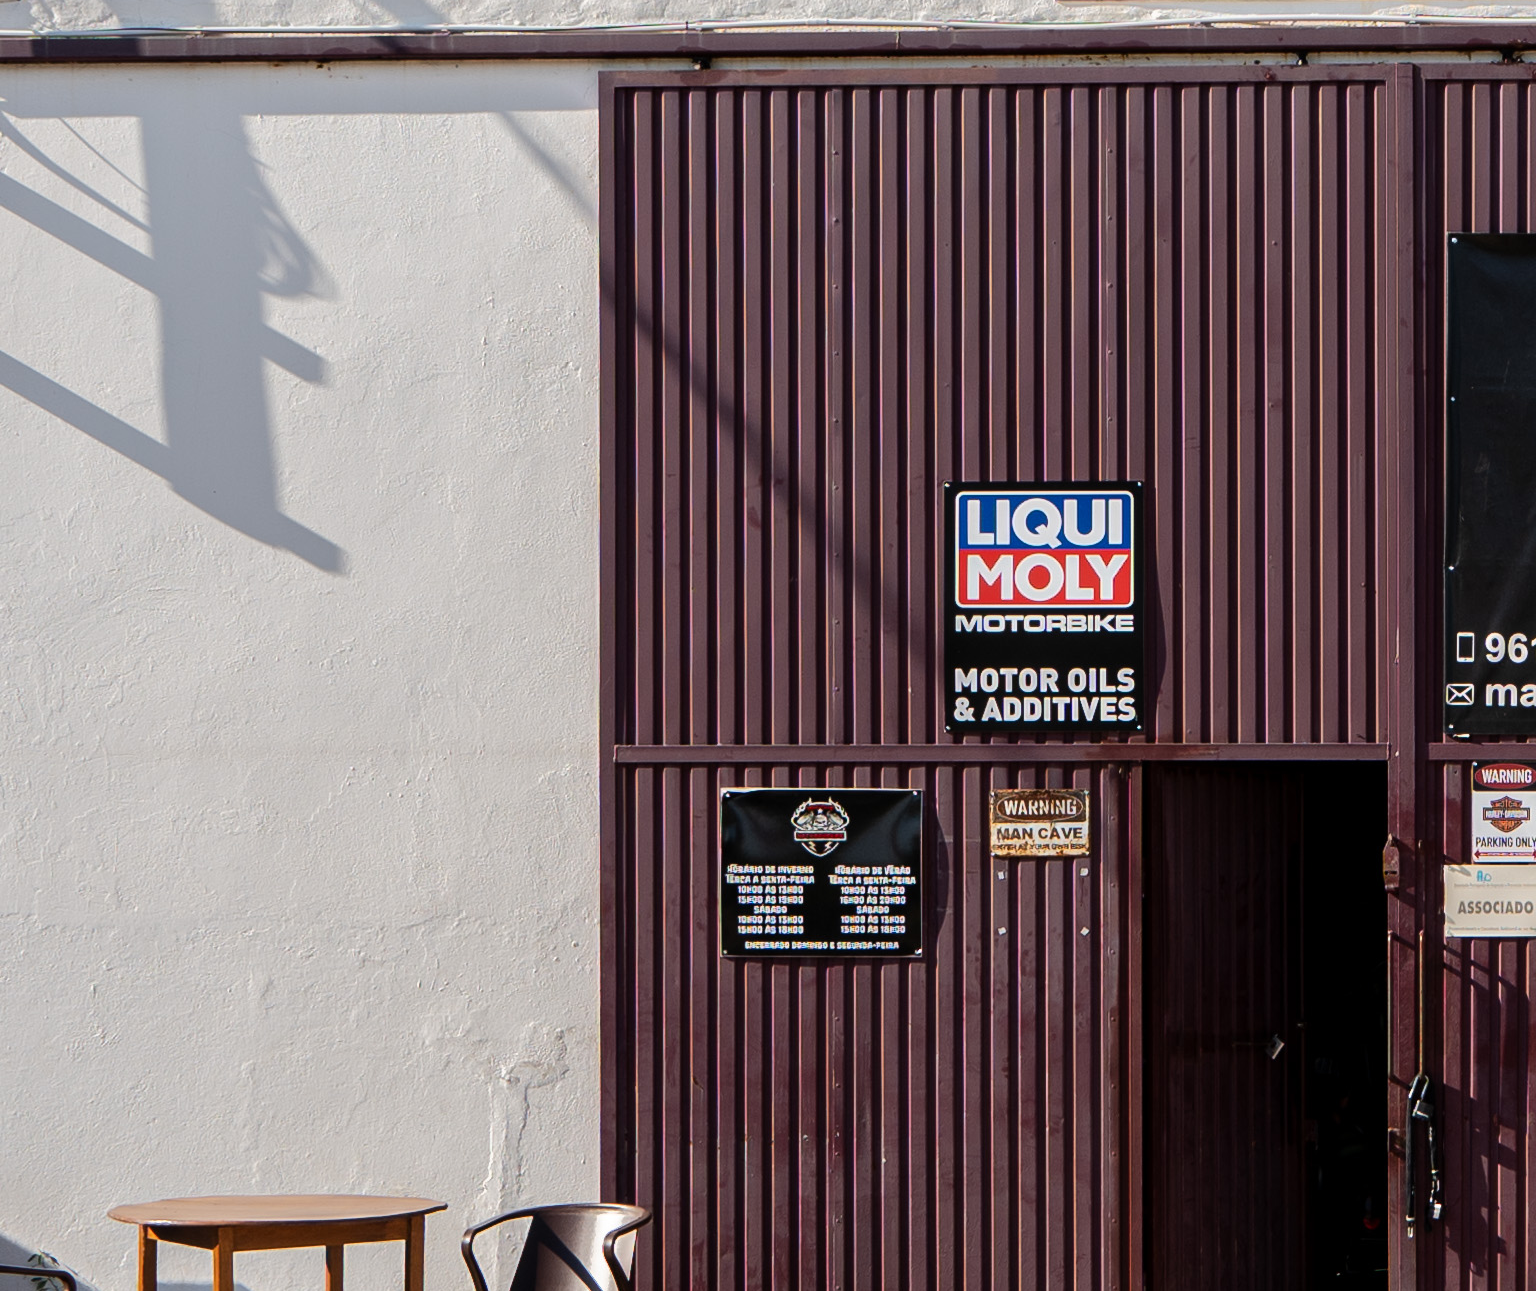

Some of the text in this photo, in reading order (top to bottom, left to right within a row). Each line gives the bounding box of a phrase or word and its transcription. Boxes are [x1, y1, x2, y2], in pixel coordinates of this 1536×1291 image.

[966, 497, 1123, 550] LIQUI
[966, 553, 1129, 602] MOLY
[955, 614, 1135, 633] MOTORBIKE
[954, 667, 1135, 693] MOTOR OILS
[953, 696, 1136, 722] & ADDITIVES
[1481, 769, 1533, 783] WARNING
[1003, 799, 1077, 815] WARNING
[997, 827, 1083, 841] MAN CAVE
[1475, 837, 1536, 847] PARKING ONLY
[1457, 901, 1534, 914] ASSOCIADO
